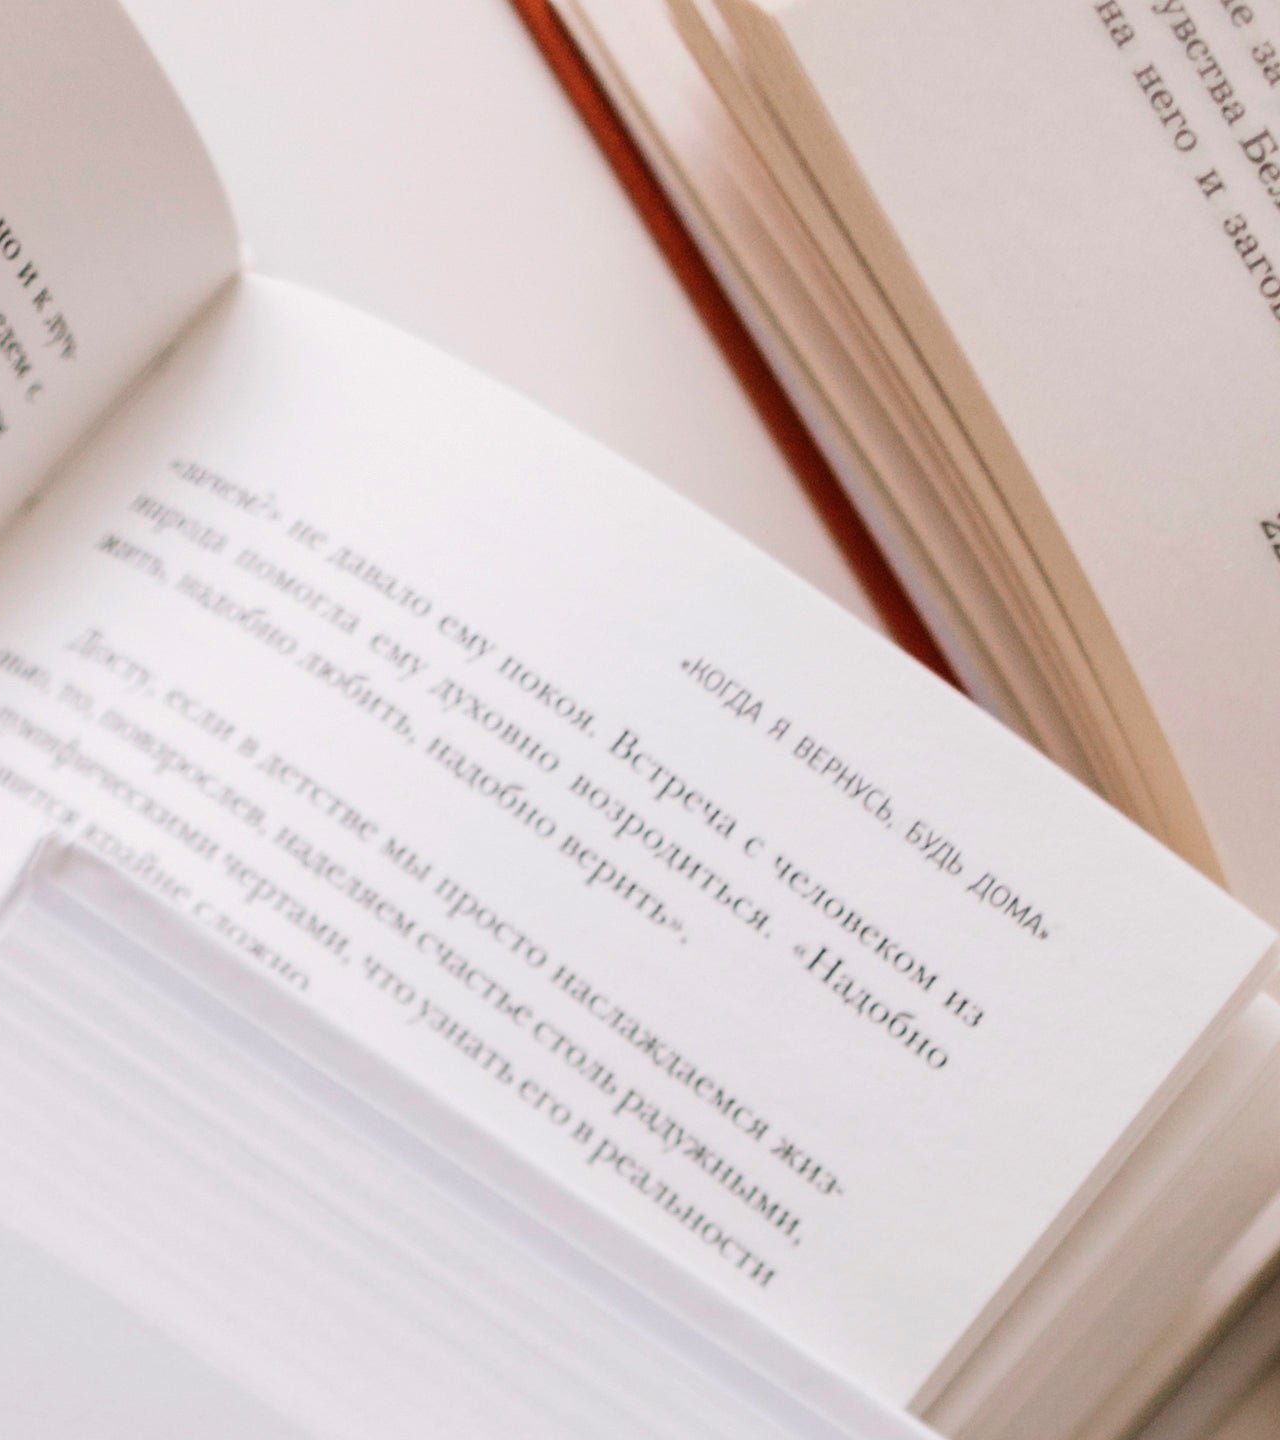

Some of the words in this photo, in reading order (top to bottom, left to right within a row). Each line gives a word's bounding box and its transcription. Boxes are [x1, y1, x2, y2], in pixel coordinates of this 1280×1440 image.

[1131, 62, 1199, 154] него
[1193, 167, 1227, 201] и
[1237, 126, 1280, 212] Бе
[766, 716, 793, 743] Я
[902, 818, 965, 878] БУДЬ
[606, 726, 738, 841] Встреча
[741, 834, 767, 860] с
[772, 852, 941, 994] человеком
[941, 988, 986, 1029] из
